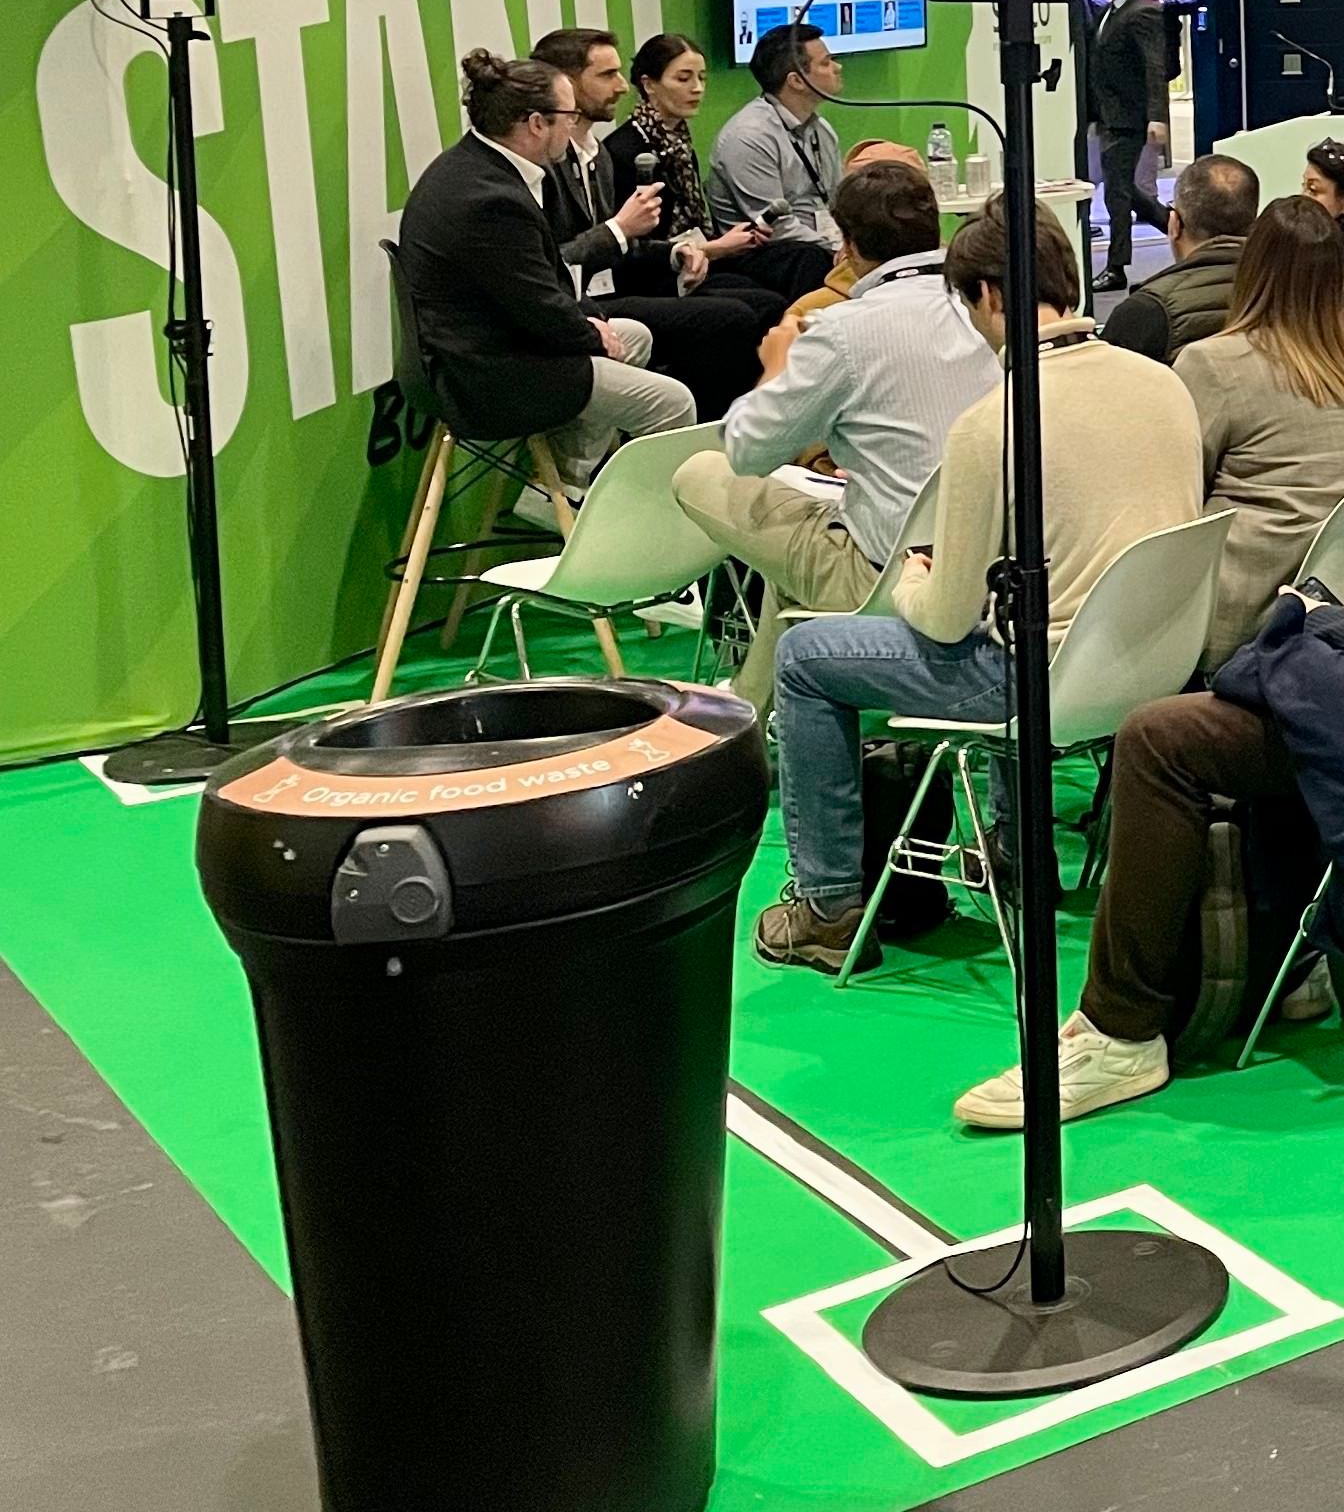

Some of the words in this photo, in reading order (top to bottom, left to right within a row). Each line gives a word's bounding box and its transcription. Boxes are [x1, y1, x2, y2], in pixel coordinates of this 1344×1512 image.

[303, 787, 419, 807] Organic
[430, 778, 506, 800] food
[519, 758, 610, 788] waste
